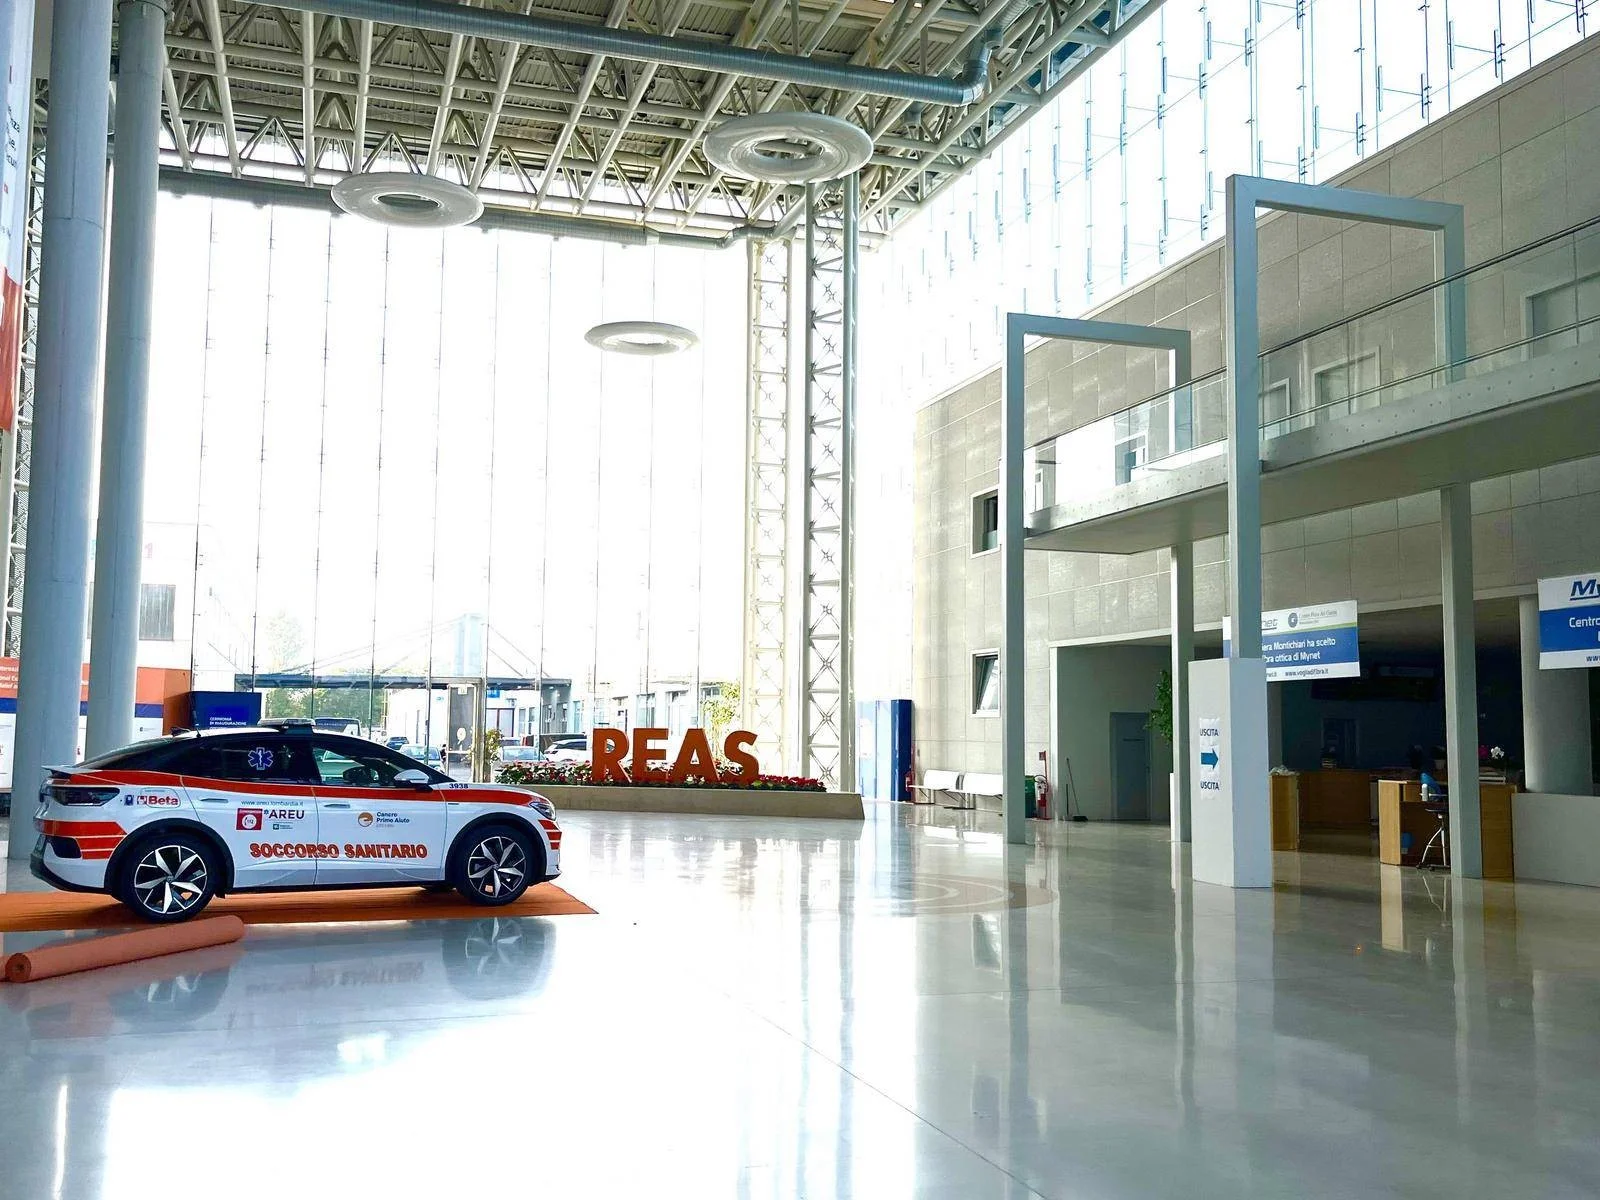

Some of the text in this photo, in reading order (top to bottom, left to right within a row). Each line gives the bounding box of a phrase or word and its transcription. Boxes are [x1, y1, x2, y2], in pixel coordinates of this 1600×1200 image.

[1307, 640, 1315, 648] ha
[1316, 637, 1336, 647] scelto
[1275, 654, 1293, 662] ottica
[1293, 653, 1300, 661] di
[1300, 651, 1320, 662] Mynet
[591, 728, 760, 786] REAS
[1200, 782, 1219, 790] USCITA
[148, 795, 179, 806] Beta
[268, 809, 305, 819] AREU
[249, 843, 428, 858] SOCCORSO SANITARIO
